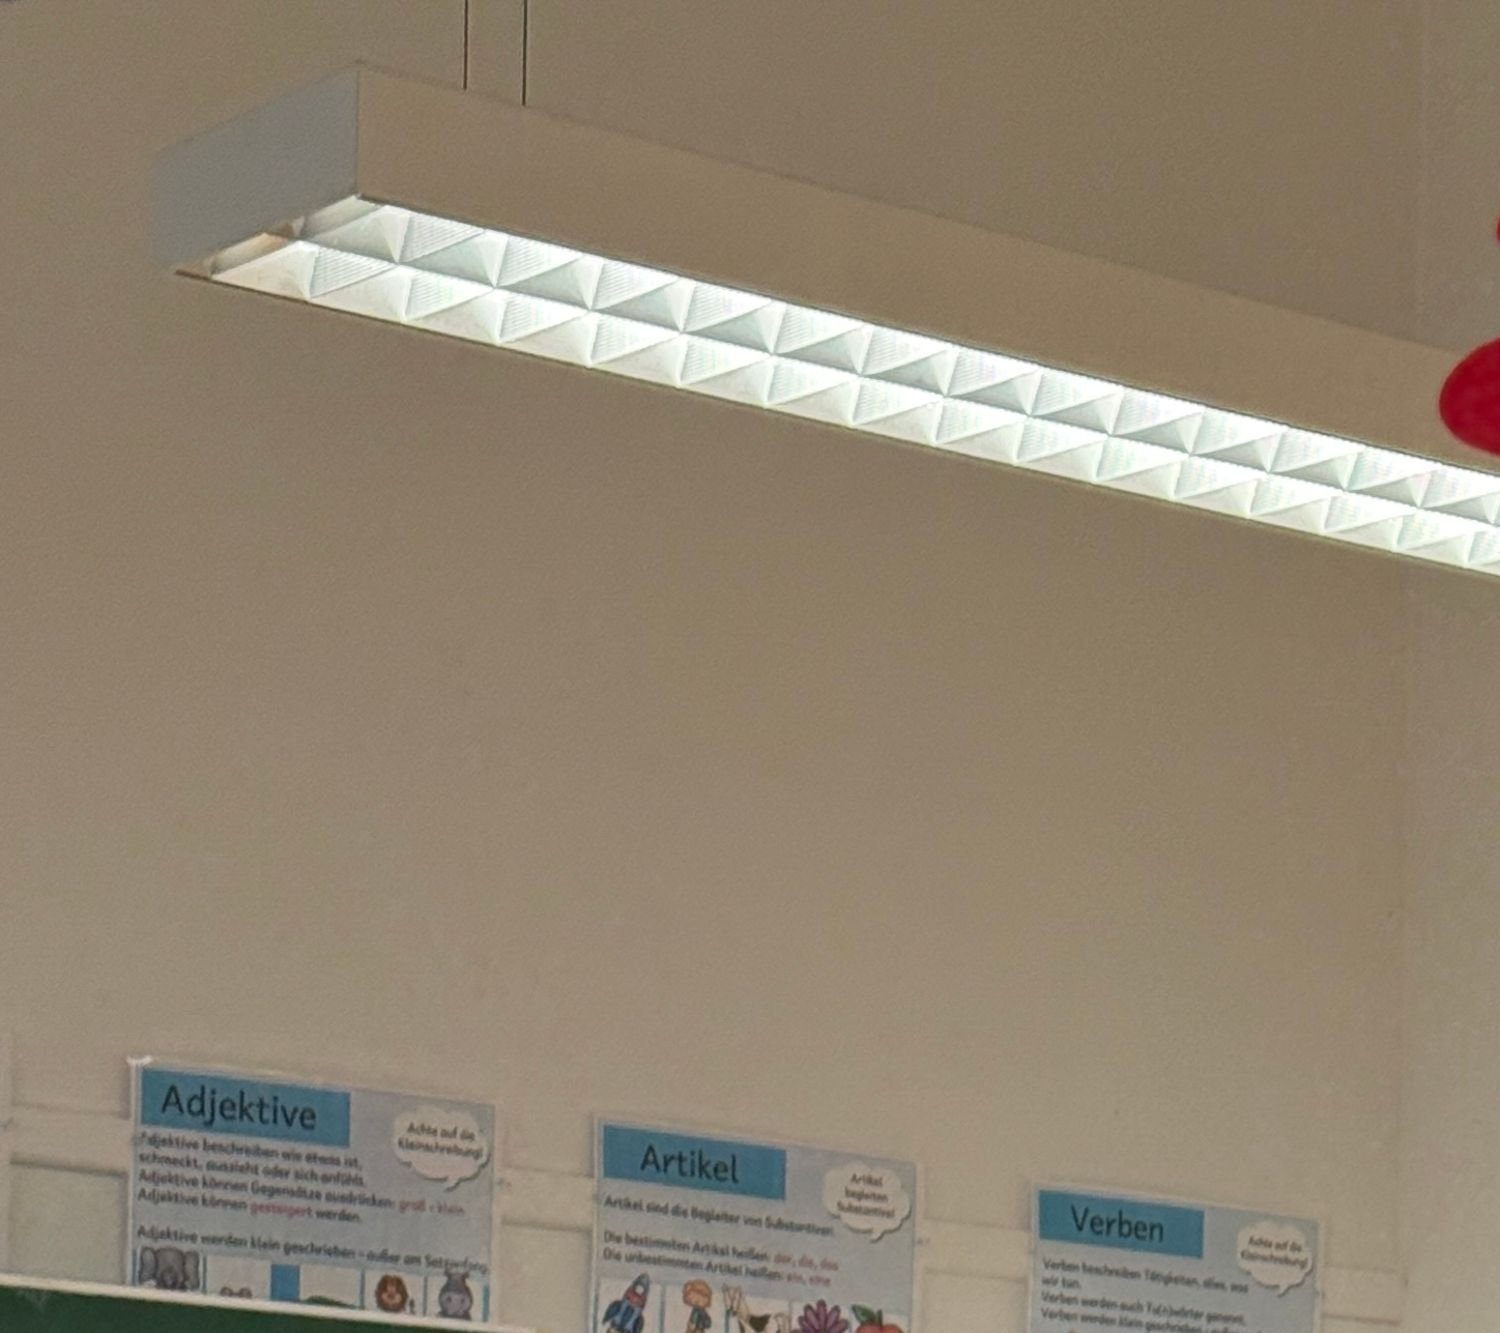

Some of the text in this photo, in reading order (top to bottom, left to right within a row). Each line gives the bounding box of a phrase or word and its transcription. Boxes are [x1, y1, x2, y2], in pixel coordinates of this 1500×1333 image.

[160, 1084, 318, 1131] Adjektive
[203, 1138, 279, 1158] beschreiben
[640, 1144, 740, 1185] Artikel
[139, 1169, 200, 1188] Adjektive
[138, 1188, 199, 1206] Adjektive
[604, 1195, 644, 1212] Artikel
[646, 1201, 669, 1215] sind
[1070, 1204, 1164, 1242] Verben
[137, 1225, 198, 1244] Adjektive
[201, 1233, 248, 1247] werden
[604, 1229, 623, 1243] Die
[692, 1241, 730, 1257] Artikel
[603, 1246, 622, 1260] Die
[705, 1260, 743, 1276] Artikel
[1042, 1257, 1080, 1271] Verben
[1041, 1289, 1079, 1305] Verben
[1040, 1306, 1078, 1321] Verben
